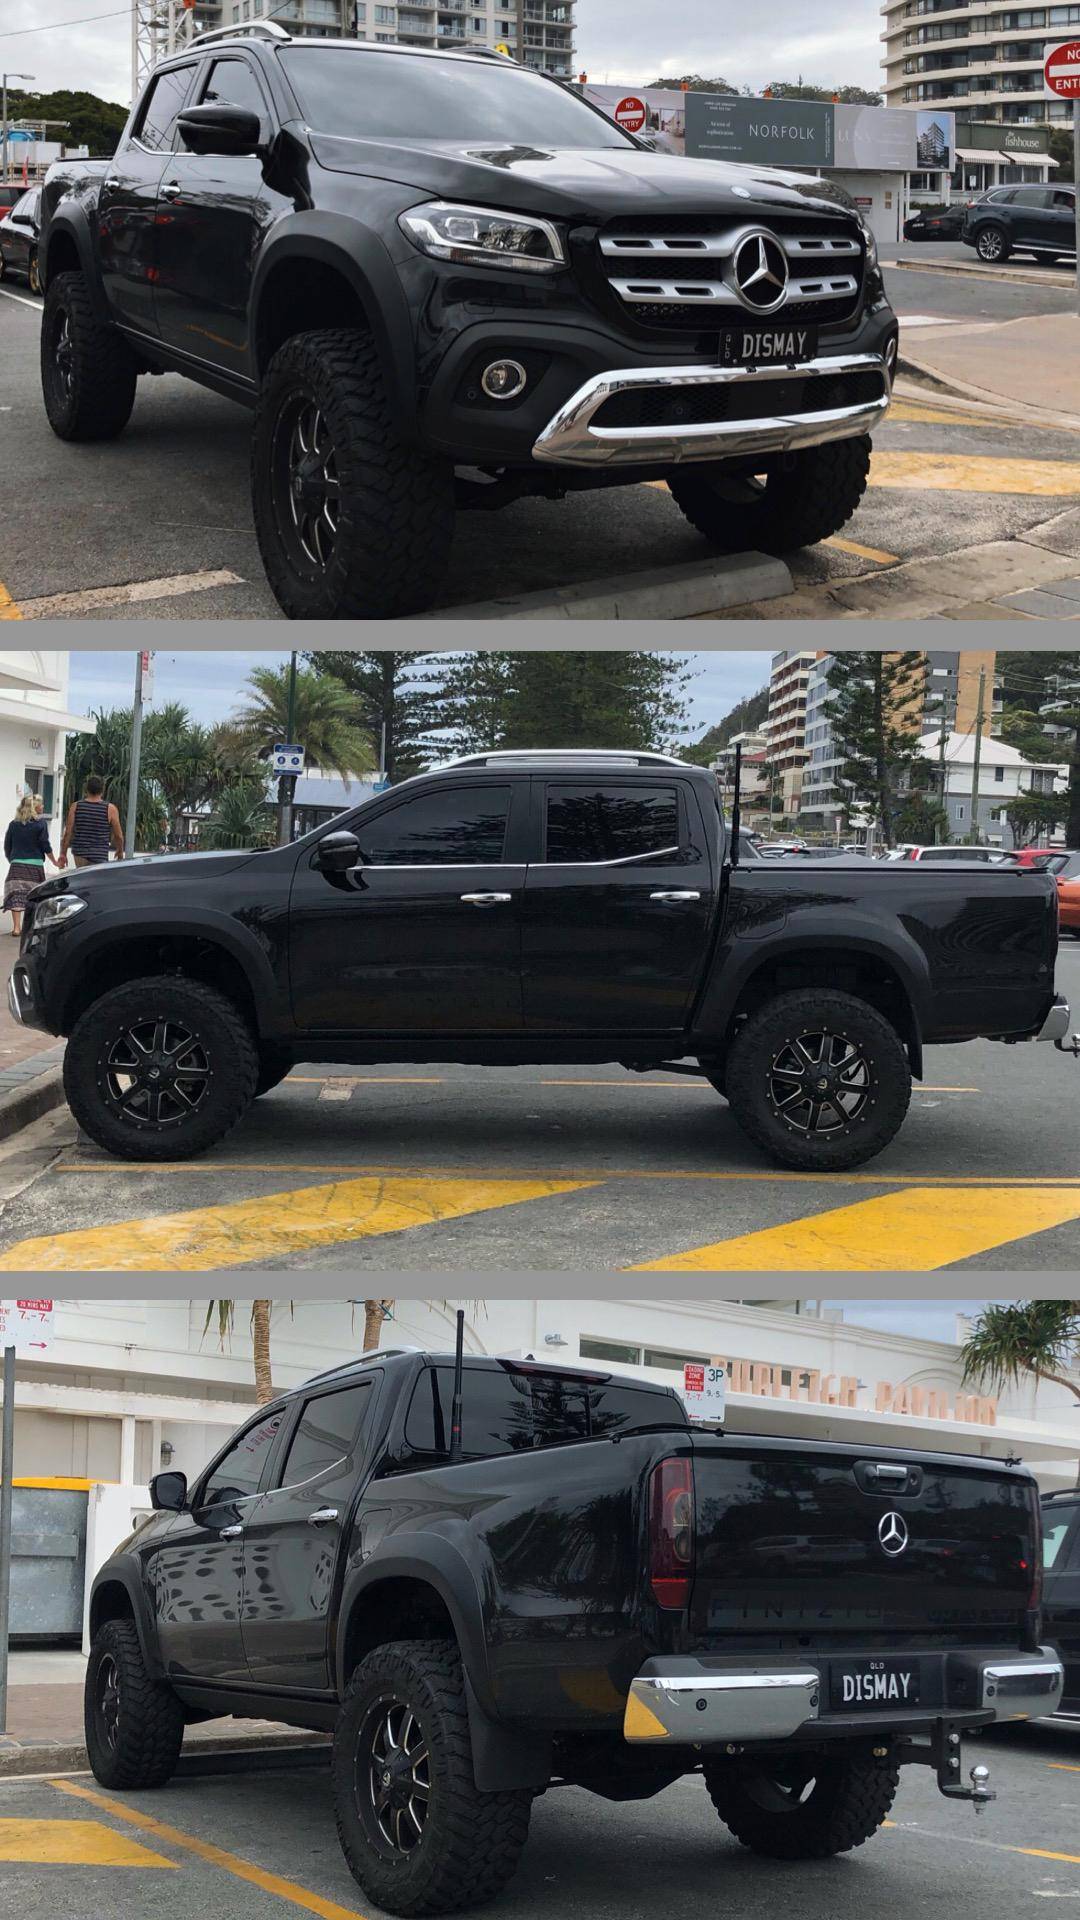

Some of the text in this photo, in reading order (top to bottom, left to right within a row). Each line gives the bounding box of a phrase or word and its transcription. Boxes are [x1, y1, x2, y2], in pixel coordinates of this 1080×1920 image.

[1055, 79, 1080, 90] ENT
[749, 123, 815, 140] NORFOLK
[1005, 136, 1040, 148] fishhouse
[741, 331, 807, 358] DISMAY
[708, 1368, 724, 1382] 3P
[711, 1356, 858, 1408] URLEIGH
[870, 1662, 885, 1670] QLD
[842, 1672, 911, 1702] DISMAY
